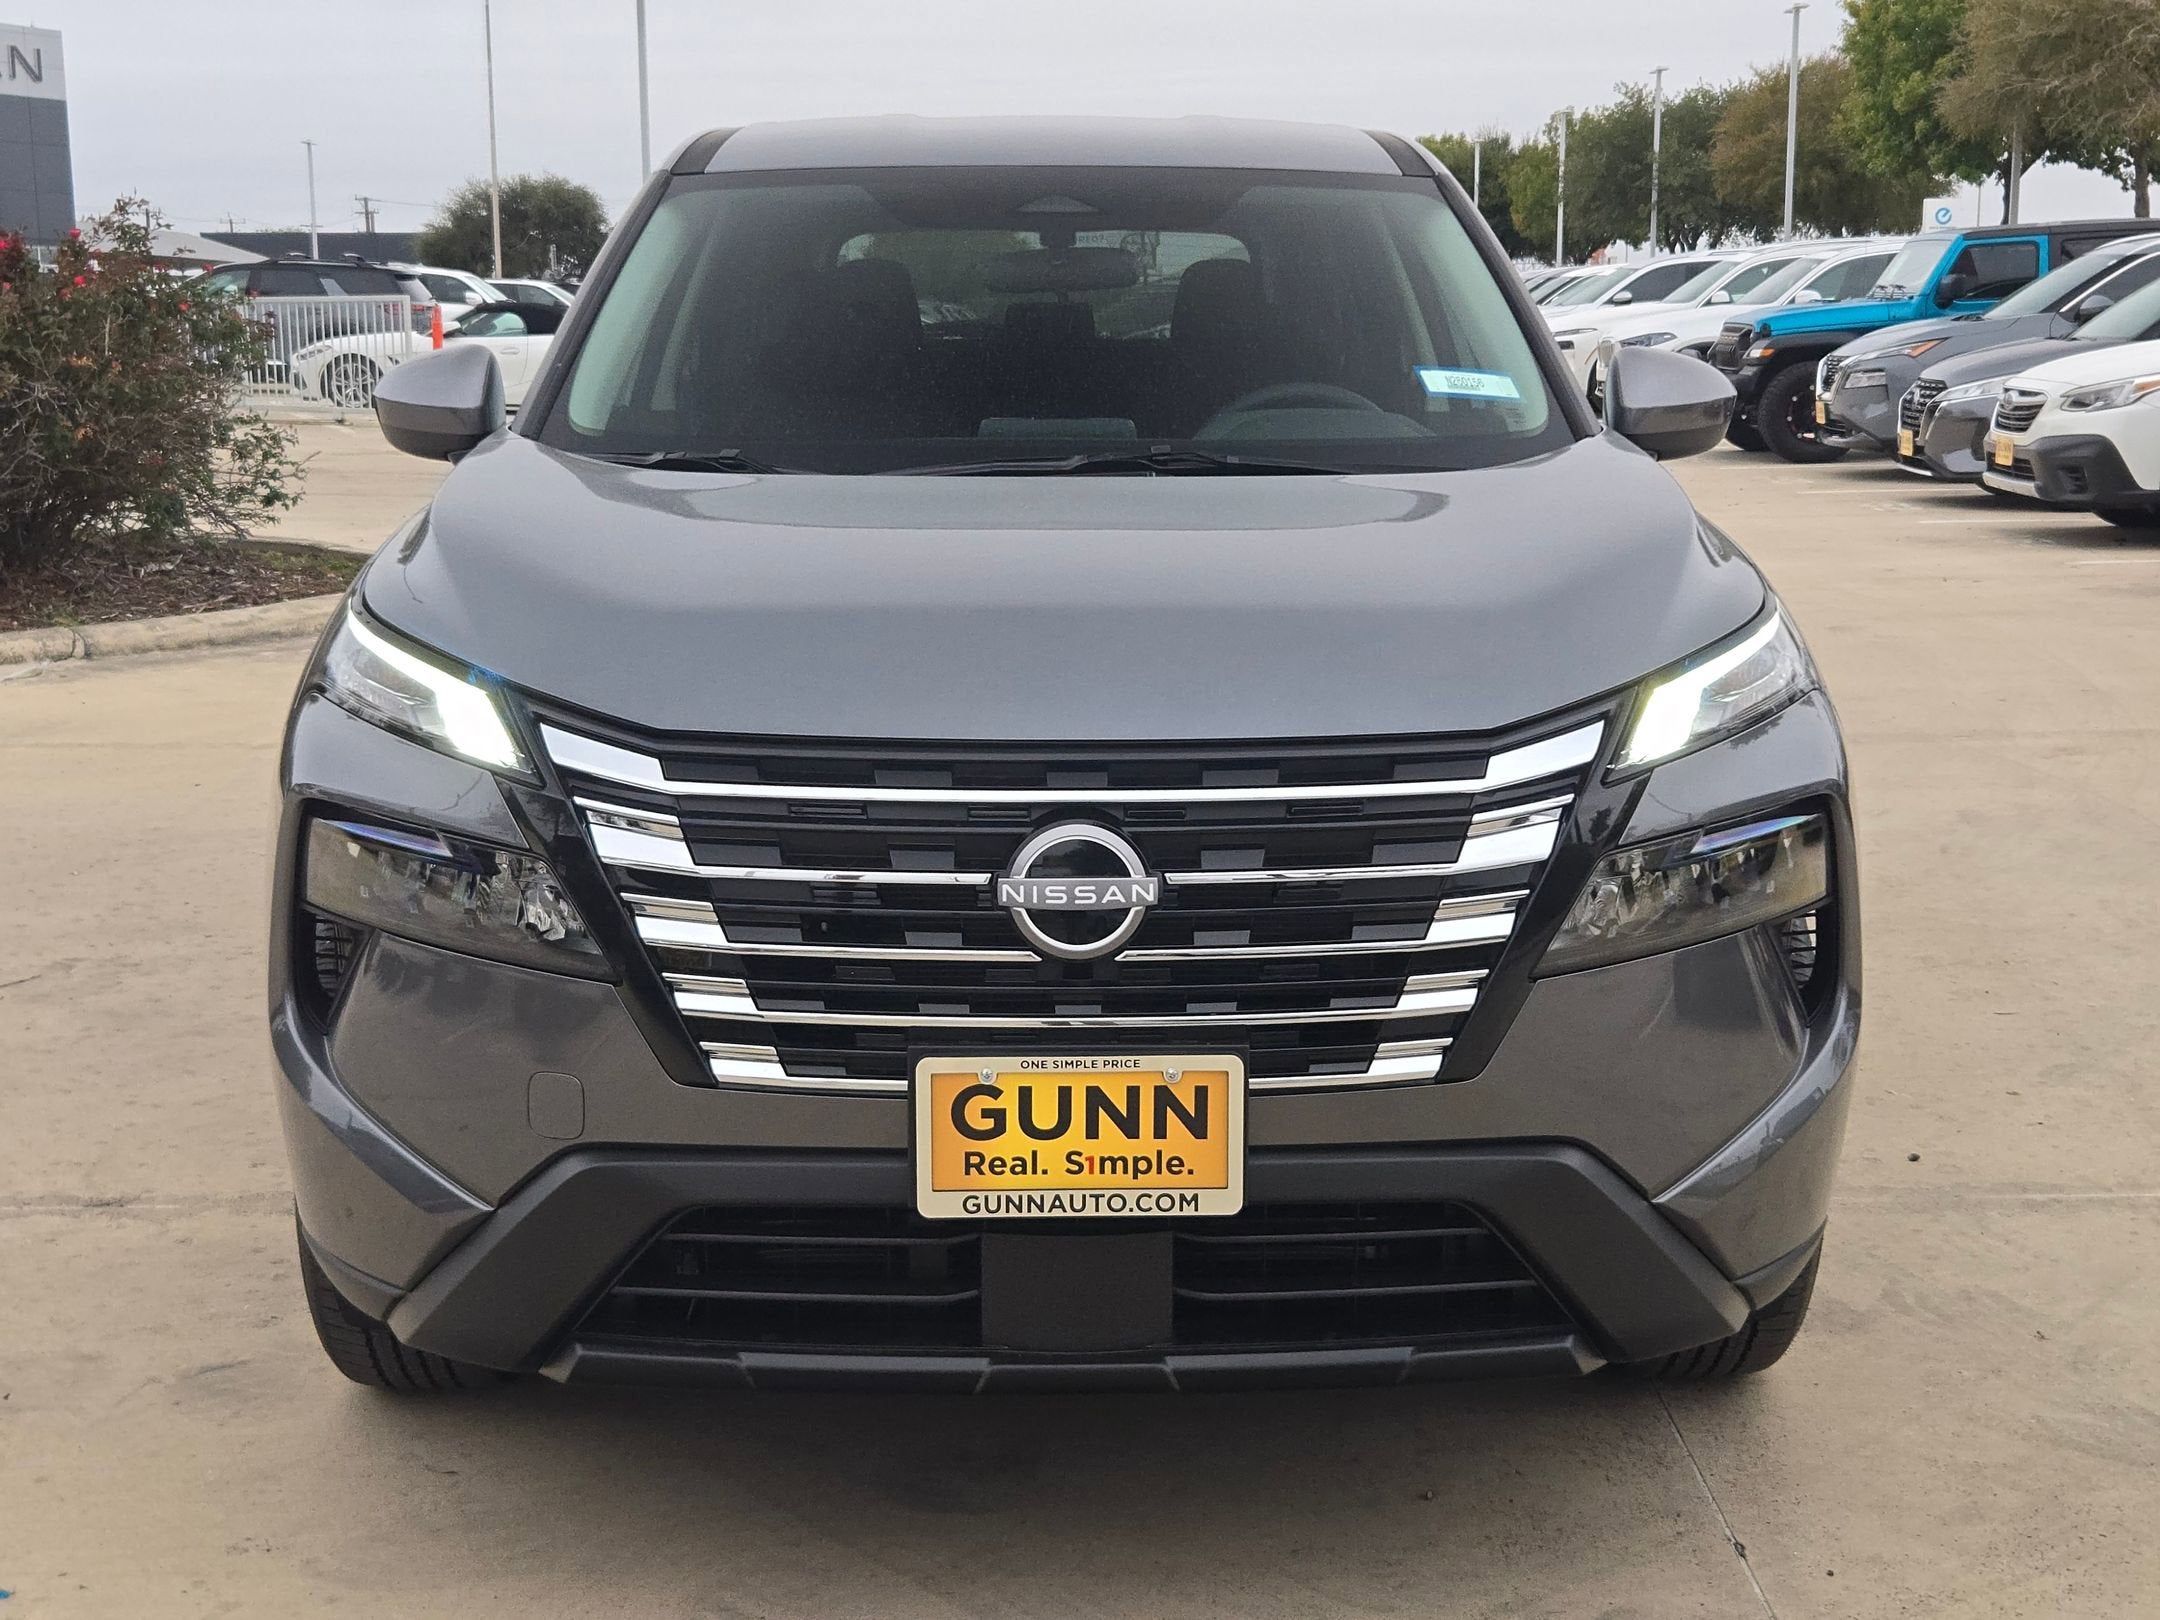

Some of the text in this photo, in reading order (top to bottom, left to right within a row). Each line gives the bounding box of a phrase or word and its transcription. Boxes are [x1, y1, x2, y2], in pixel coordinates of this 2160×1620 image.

[0, 44, 43, 83] N
[1001, 883, 1156, 905] NISSAN
[1020, 1059, 1141, 1070] ONE SIMPLE PRICE
[950, 1083, 1208, 1141] GUNN
[963, 1150, 1048, 1176] Real.
[962, 1192, 1199, 1214] GUNNAUTO.COM
